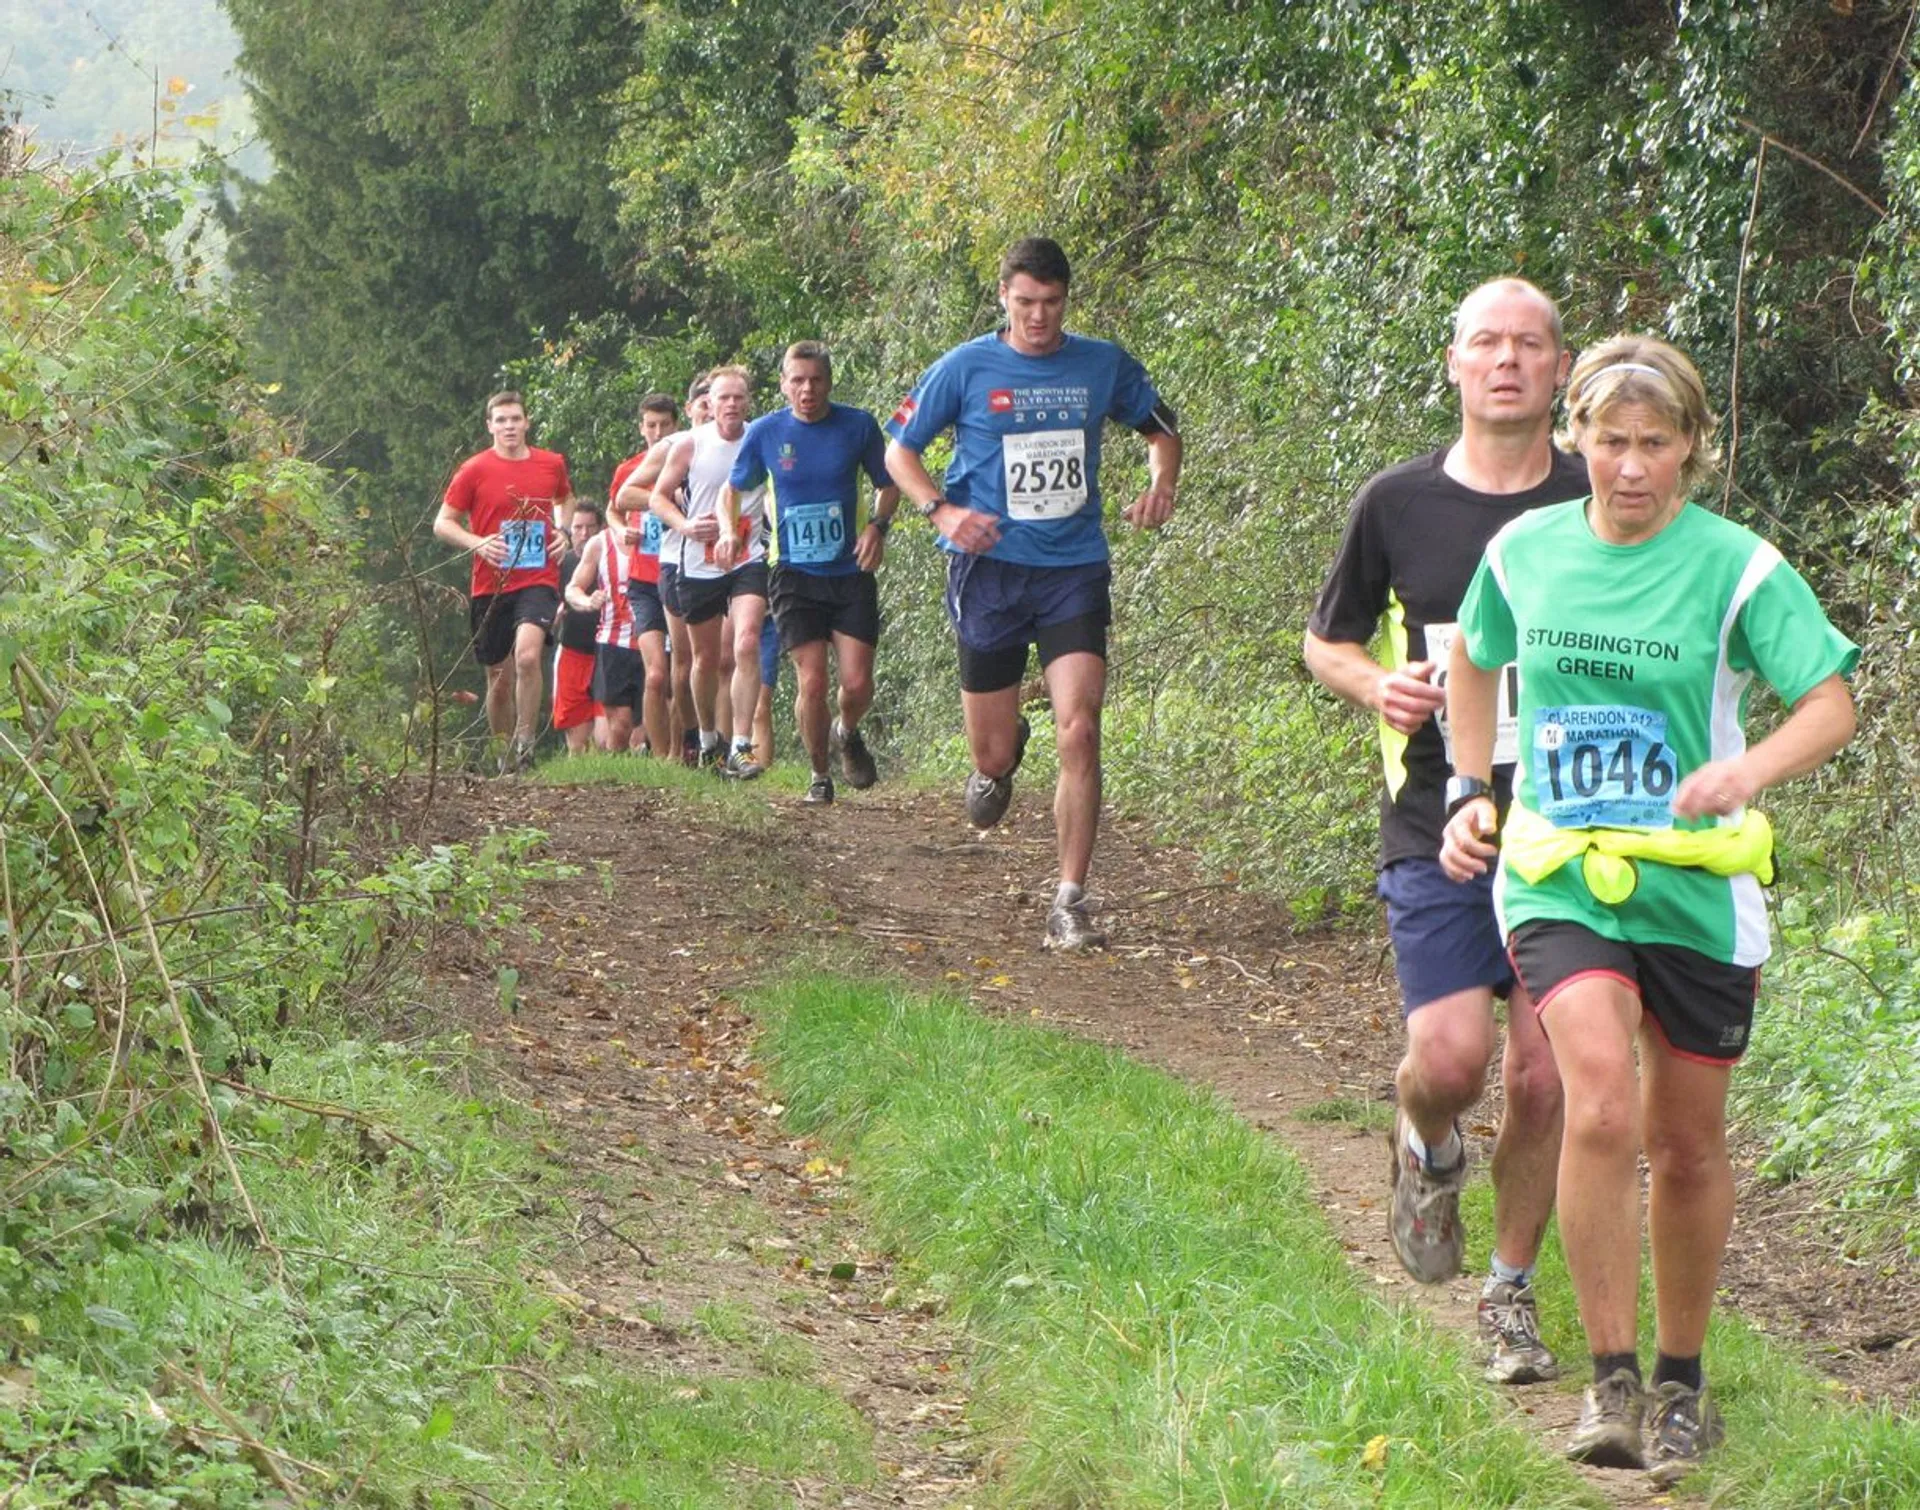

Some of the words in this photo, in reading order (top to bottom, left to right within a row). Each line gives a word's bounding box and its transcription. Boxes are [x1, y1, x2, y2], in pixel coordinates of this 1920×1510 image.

[1013, 387, 1030, 397] THE
[1032, 386, 1064, 396] NORTH
[1065, 386, 1089, 395] FACE
[1026, 448, 1067, 459] MARATHON
[1010, 456, 1083, 493] 2528
[792, 518, 843, 546] 1410
[1526, 628, 1679, 662] STUBBINGTON
[1556, 656, 1634, 681] GREEN
[1548, 710, 1626, 726] CLARENDON
[1565, 727, 1641, 743] MARATHON
[1547, 740, 1674, 802] 1046
